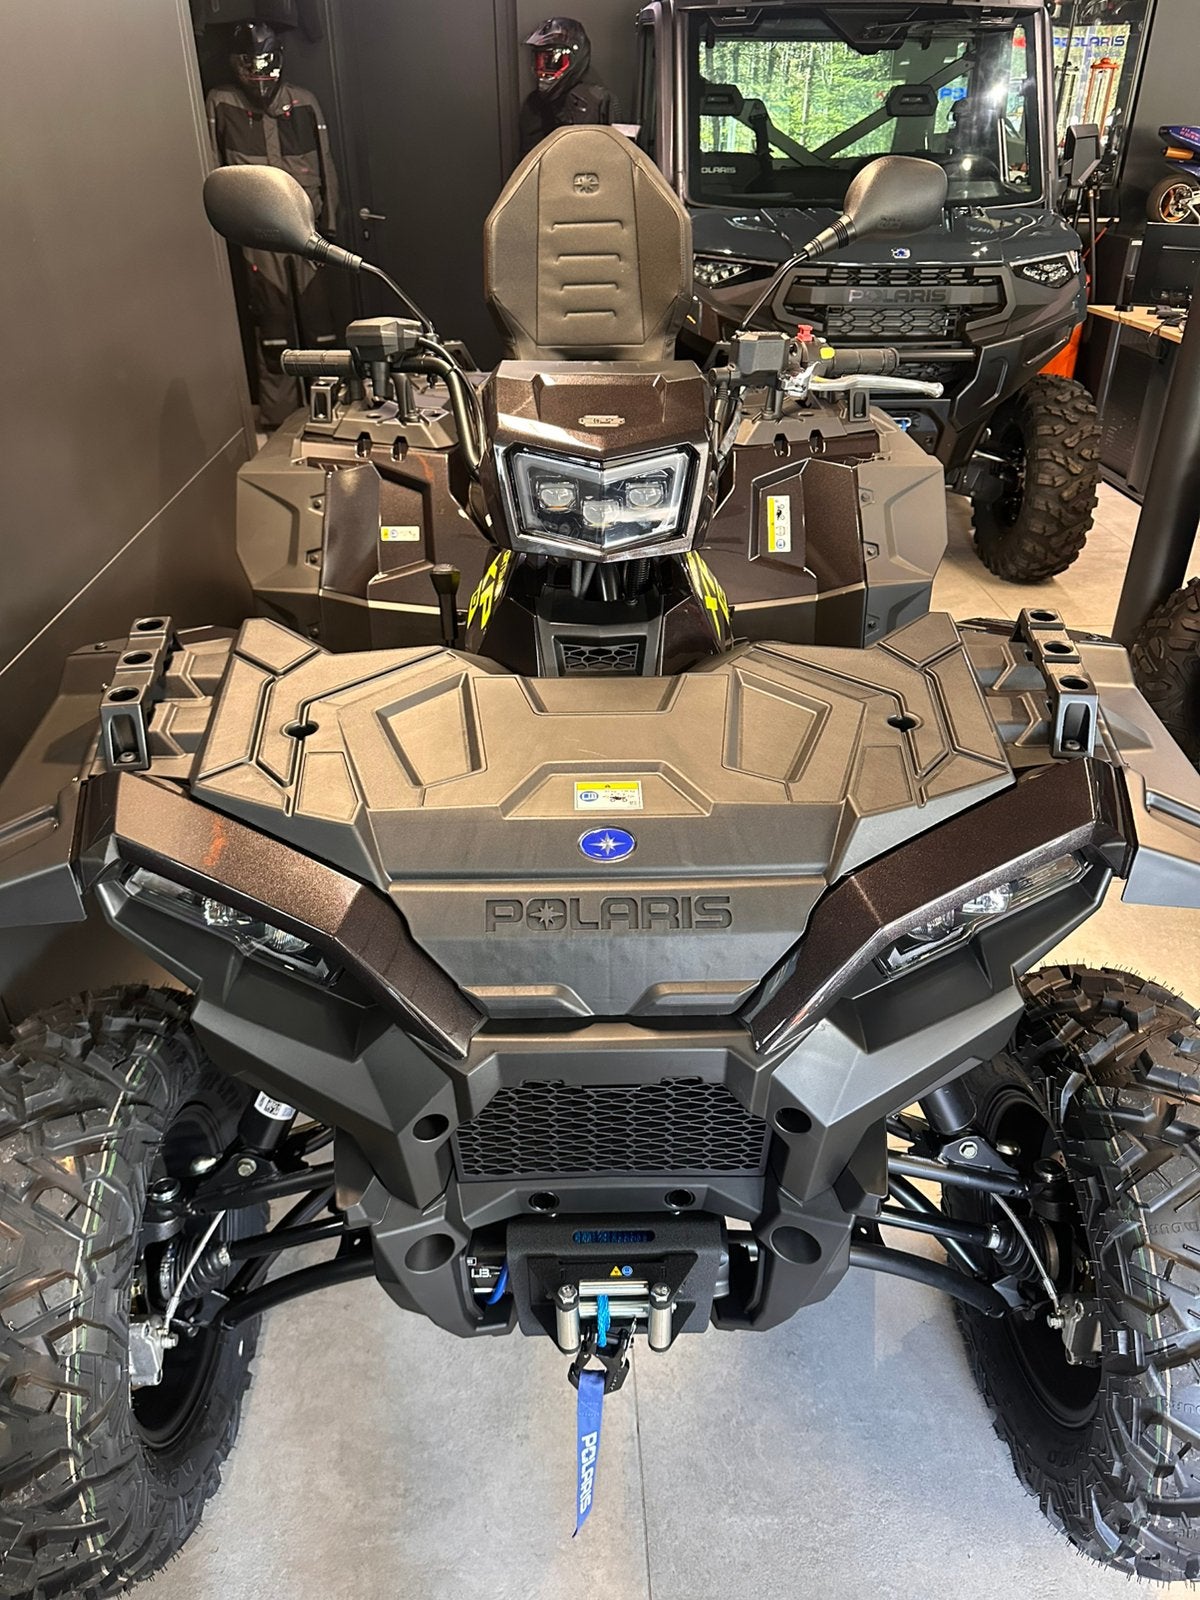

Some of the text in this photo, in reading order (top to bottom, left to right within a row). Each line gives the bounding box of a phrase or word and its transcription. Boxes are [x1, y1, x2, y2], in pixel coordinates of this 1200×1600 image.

[701, 166, 737, 174] OLARIS
[848, 289, 947, 303] POLARIS
[485, 896, 733, 932] POLARIS
[580, 1431, 598, 1515] POLARIS
